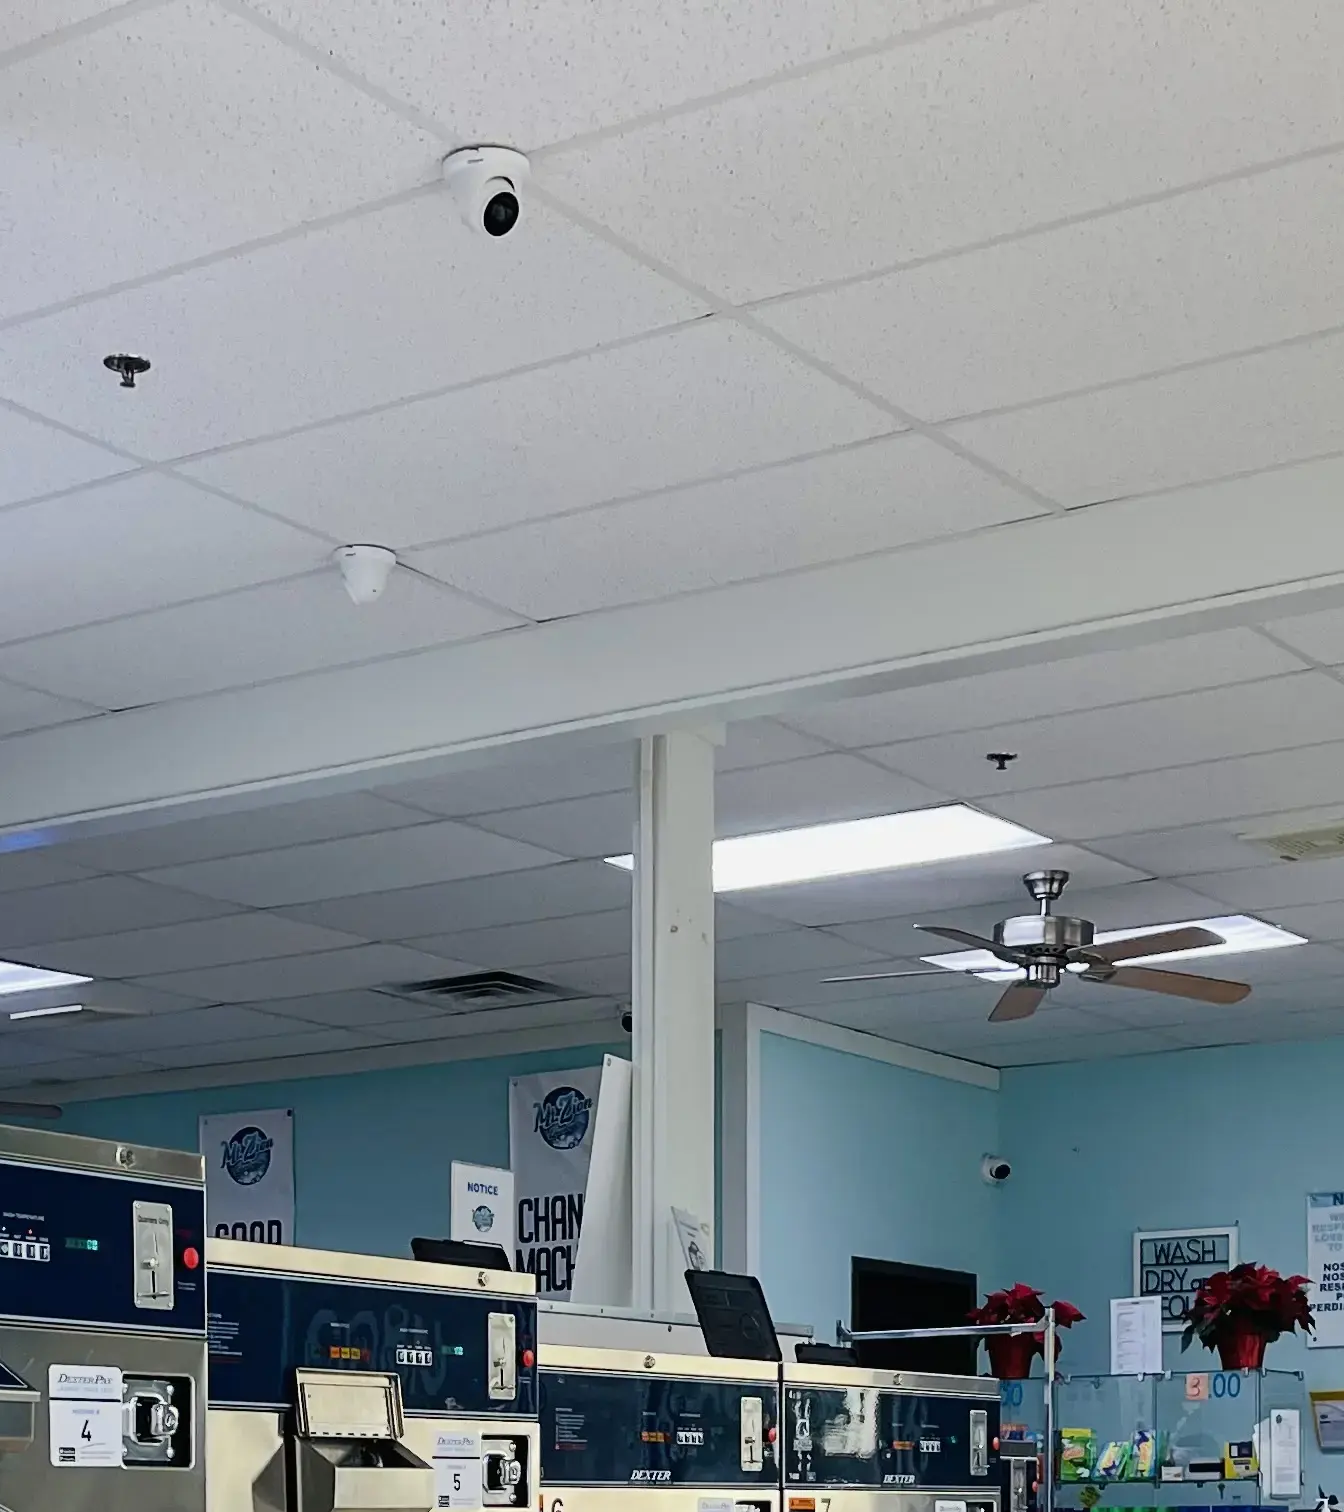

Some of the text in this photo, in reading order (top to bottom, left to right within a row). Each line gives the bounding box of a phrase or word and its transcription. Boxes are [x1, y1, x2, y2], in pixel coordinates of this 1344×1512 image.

[467, 1181, 499, 1196] NOTICE
[517, 1193, 586, 1244] CHAN
[1153, 1239, 1216, 1265] WASH
[1145, 1267, 1188, 1293] DRY
[80, 1419, 93, 1442] 4
[453, 1473, 461, 1492] 5
[630, 1469, 672, 1481] DEXTER
[883, 1474, 916, 1485] DEXTER
